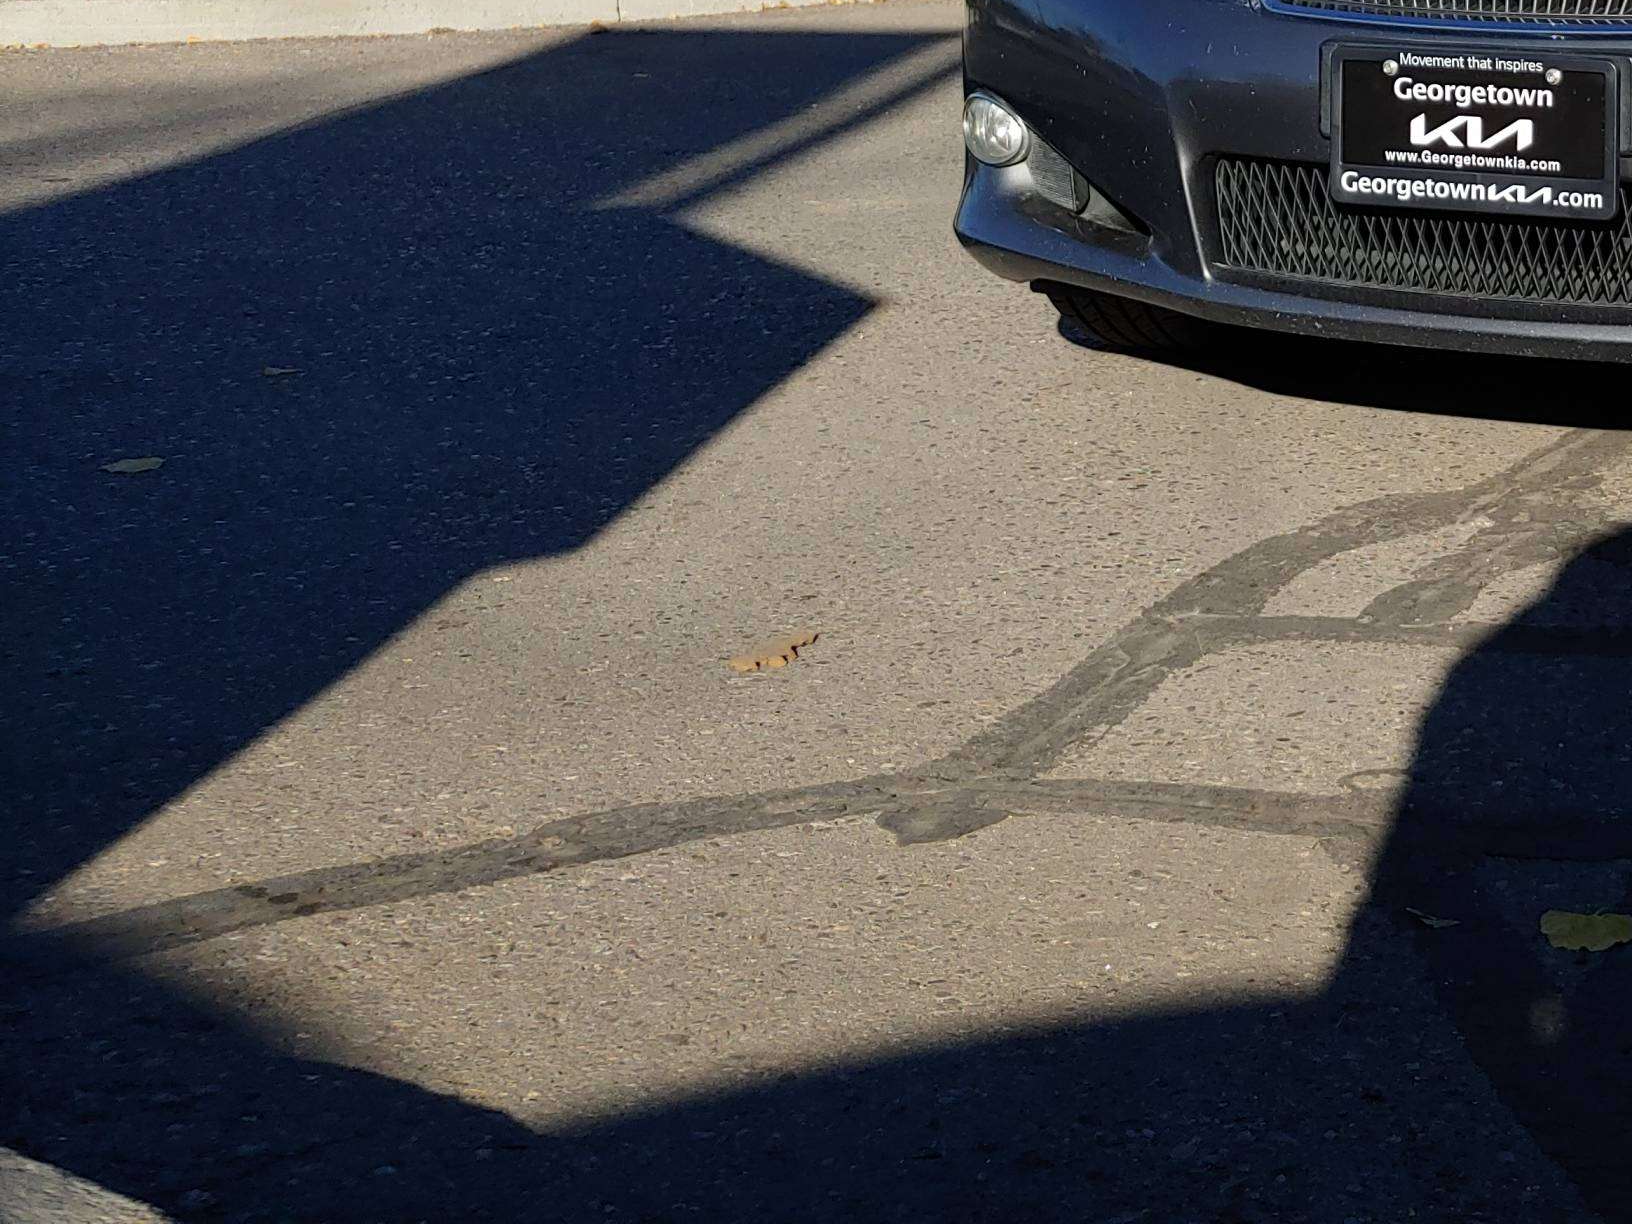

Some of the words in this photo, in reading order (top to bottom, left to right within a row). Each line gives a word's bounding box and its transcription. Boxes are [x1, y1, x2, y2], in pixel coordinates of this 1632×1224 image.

[1400, 53, 1465, 69] Movement
[1467, 57, 1492, 70] that
[1495, 58, 1543, 72] inspires
[1393, 76, 1554, 108] Georgetown
[1410, 113, 1534, 152] KIA
[1385, 149, 1561, 172] www.Georgetownkia.com
